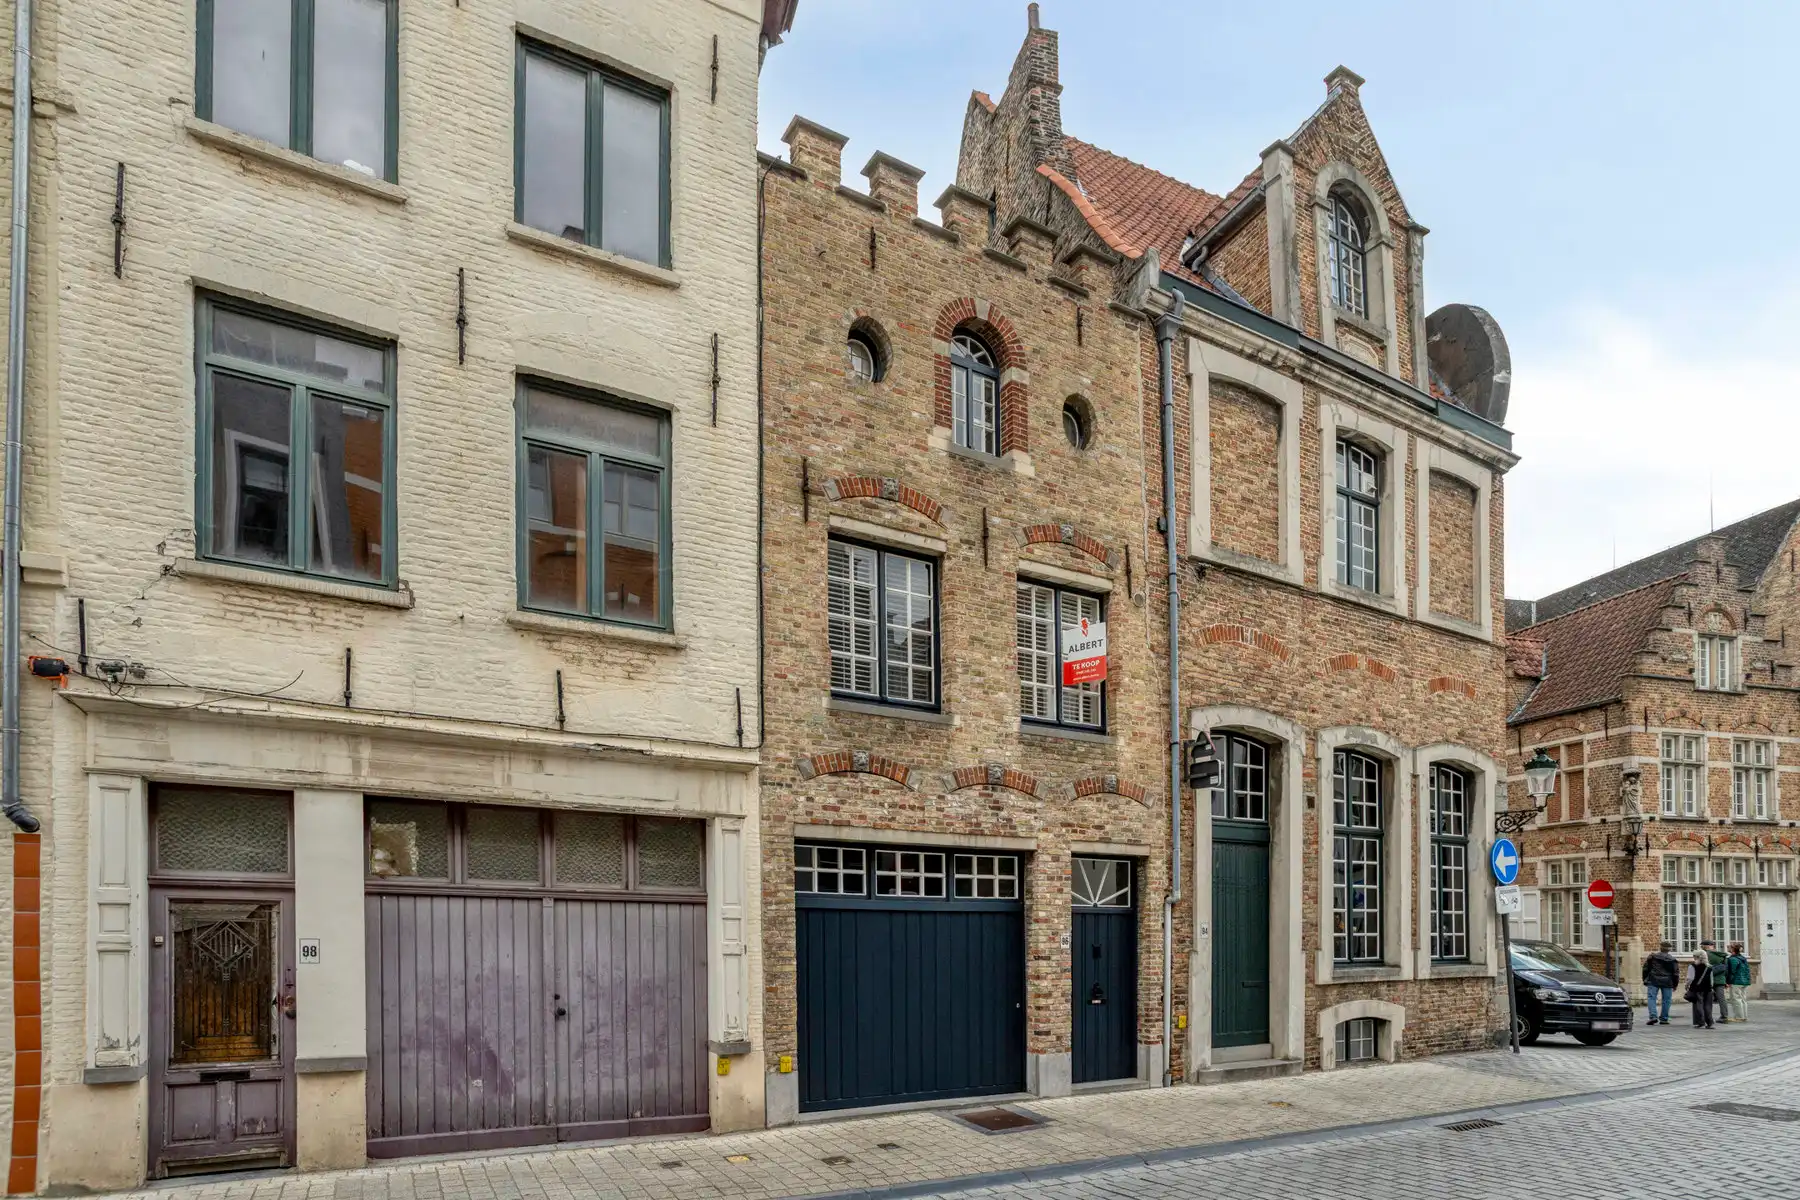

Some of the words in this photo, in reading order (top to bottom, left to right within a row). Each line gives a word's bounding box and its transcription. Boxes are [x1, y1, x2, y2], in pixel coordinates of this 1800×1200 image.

[1068, 639, 1104, 653] ALBERT
[1081, 660, 1100, 669] KOOP
[302, 945, 317, 957] 98
